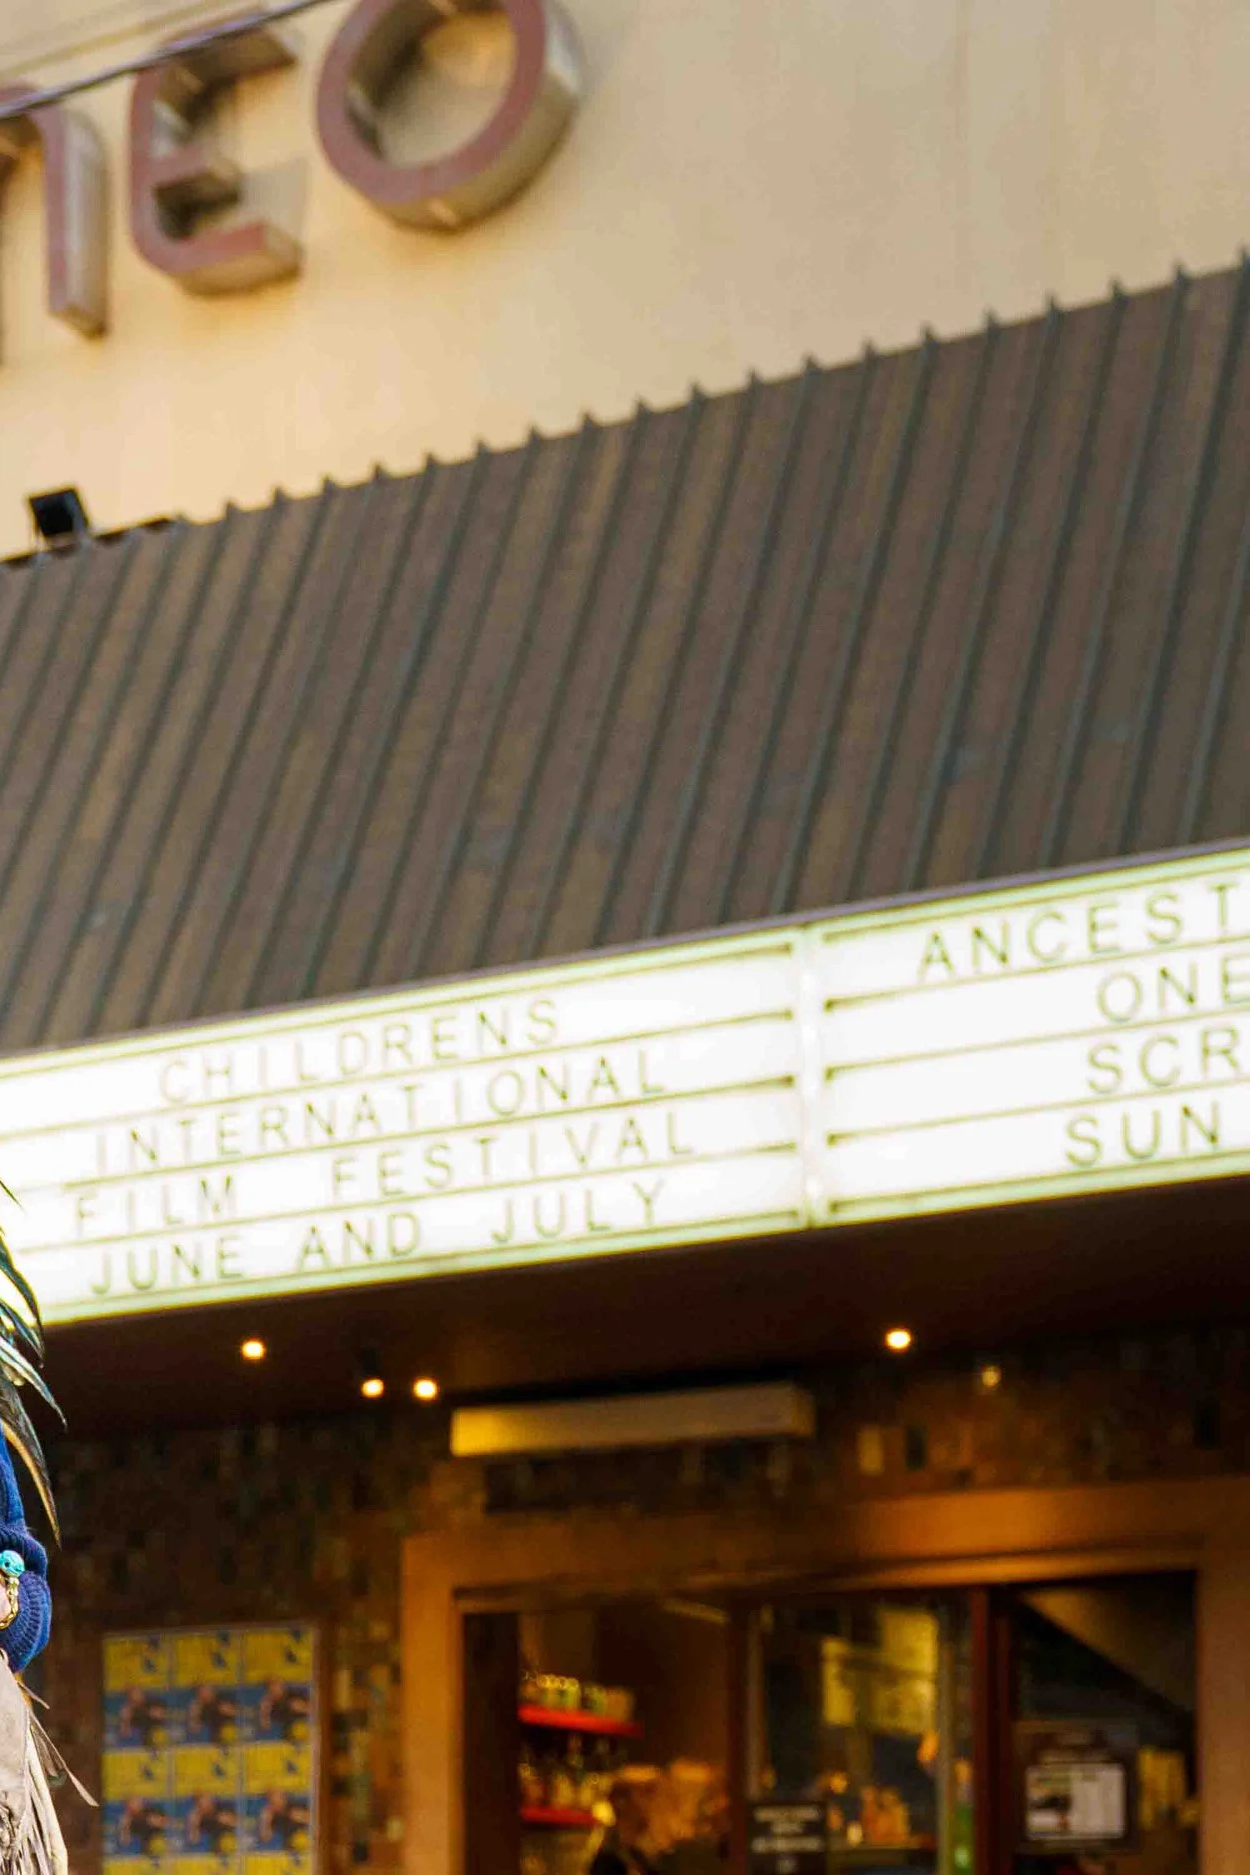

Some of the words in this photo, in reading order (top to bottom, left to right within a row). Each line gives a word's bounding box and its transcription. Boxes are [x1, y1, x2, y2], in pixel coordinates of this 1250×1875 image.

[94, 1049, 667, 1176] INTERNATIONAL
[158, 997, 561, 1106] CHILDRENS
[75, 1171, 237, 1239] FILM
[332, 1110, 695, 1202] FESTIVAL
[91, 1233, 247, 1297] JUNE
[295, 1209, 423, 1272] AND
[489, 1180, 666, 1248] JULY
